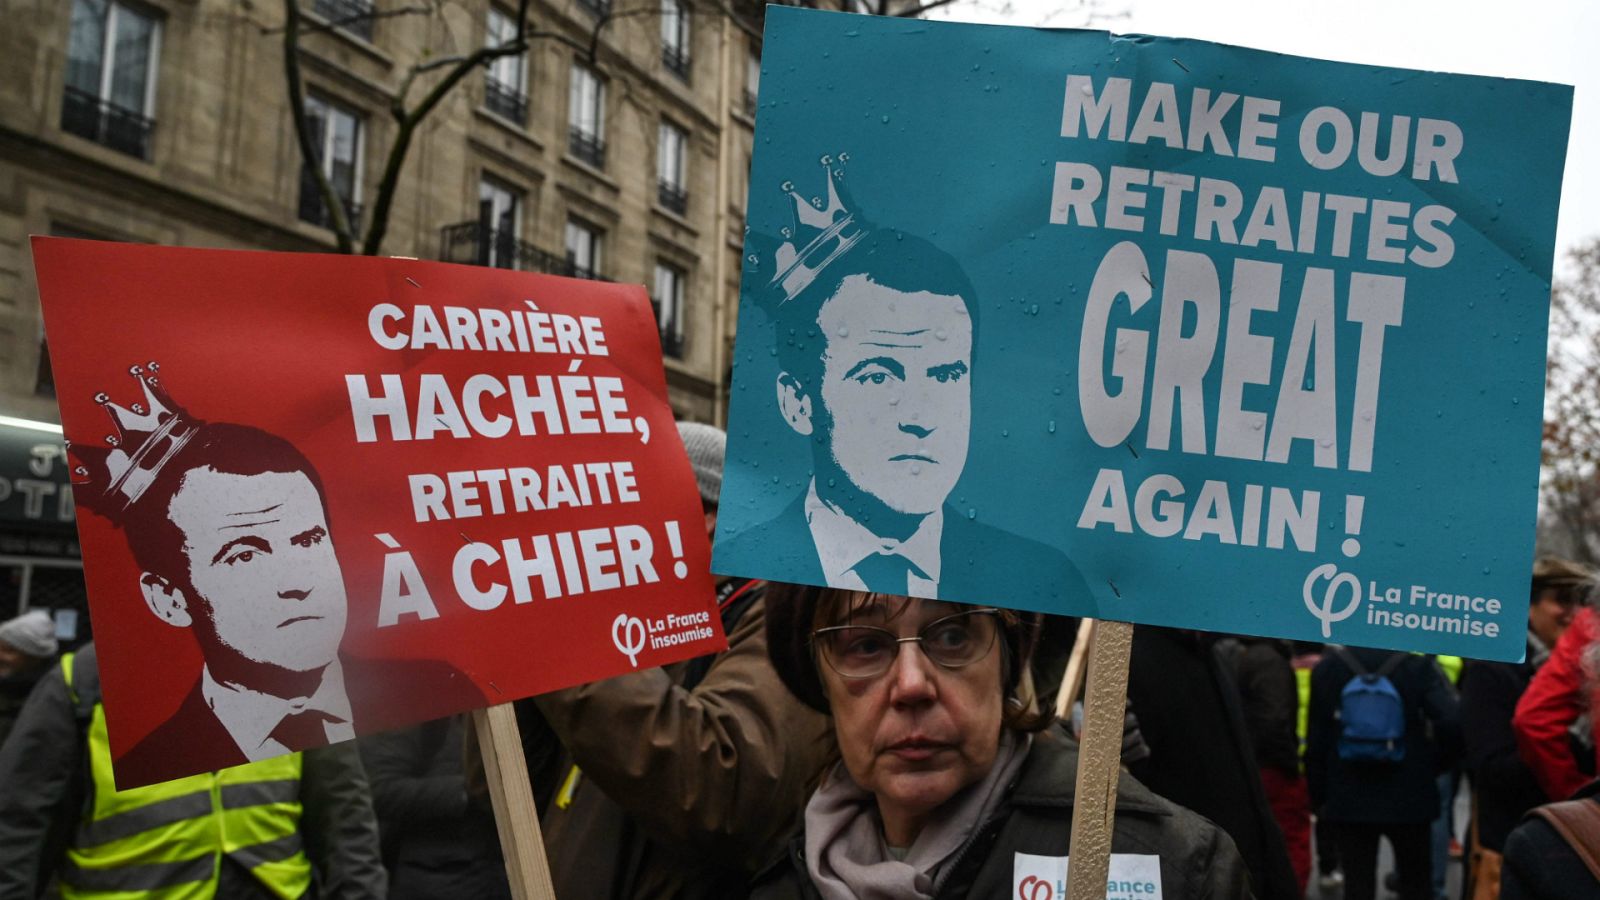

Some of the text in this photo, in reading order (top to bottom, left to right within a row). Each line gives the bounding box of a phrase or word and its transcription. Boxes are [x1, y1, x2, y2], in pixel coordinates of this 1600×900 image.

[1060, 74, 1464, 184] MAKE OUR
[1049, 161, 1457, 268] RETRAITES
[367, 300, 609, 356] CARRIÈRE
[1077, 240, 1407, 473] GREAT
[345, 359, 651, 445] HACHÉE,
[408, 461, 641, 523] RETRAITE
[1076, 468, 1366, 558] AGAIN !
[374, 520, 688, 628] À CHIER !
[1369, 581, 1502, 614] La France
[646, 611, 710, 633] La France
[650, 626, 713, 649] insoumise
[1367, 603, 1500, 638] insoumise
[1107, 880, 1156, 894] ance
